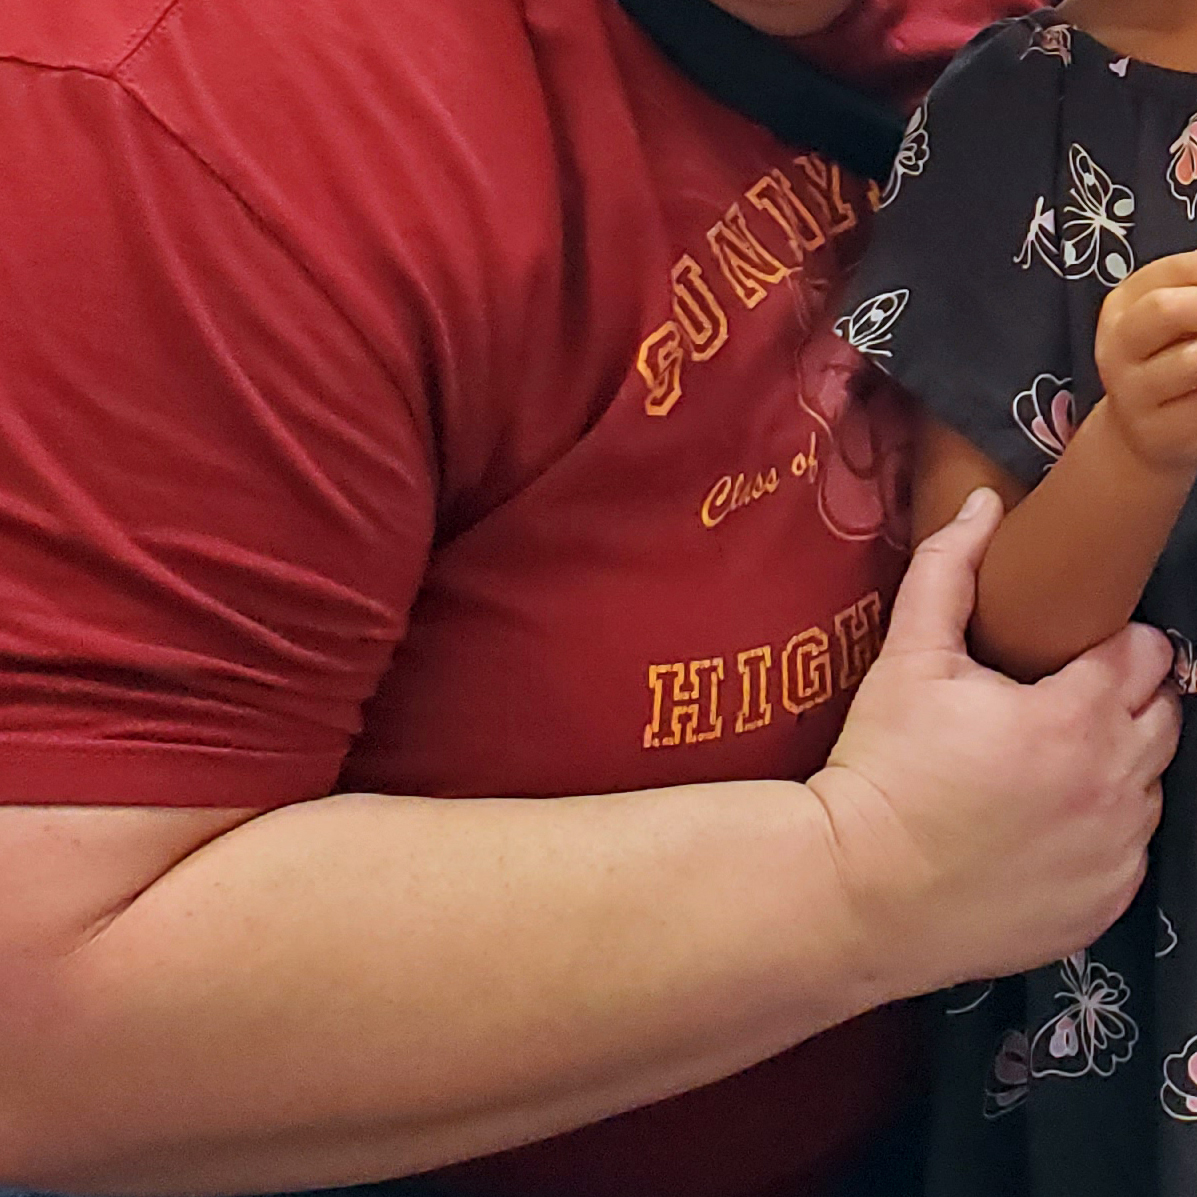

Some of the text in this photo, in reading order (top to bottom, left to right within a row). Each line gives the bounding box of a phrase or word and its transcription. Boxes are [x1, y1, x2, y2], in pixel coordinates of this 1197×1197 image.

[701, 431, 819, 528] Class of
[643, 591, 881, 748] HIGH
